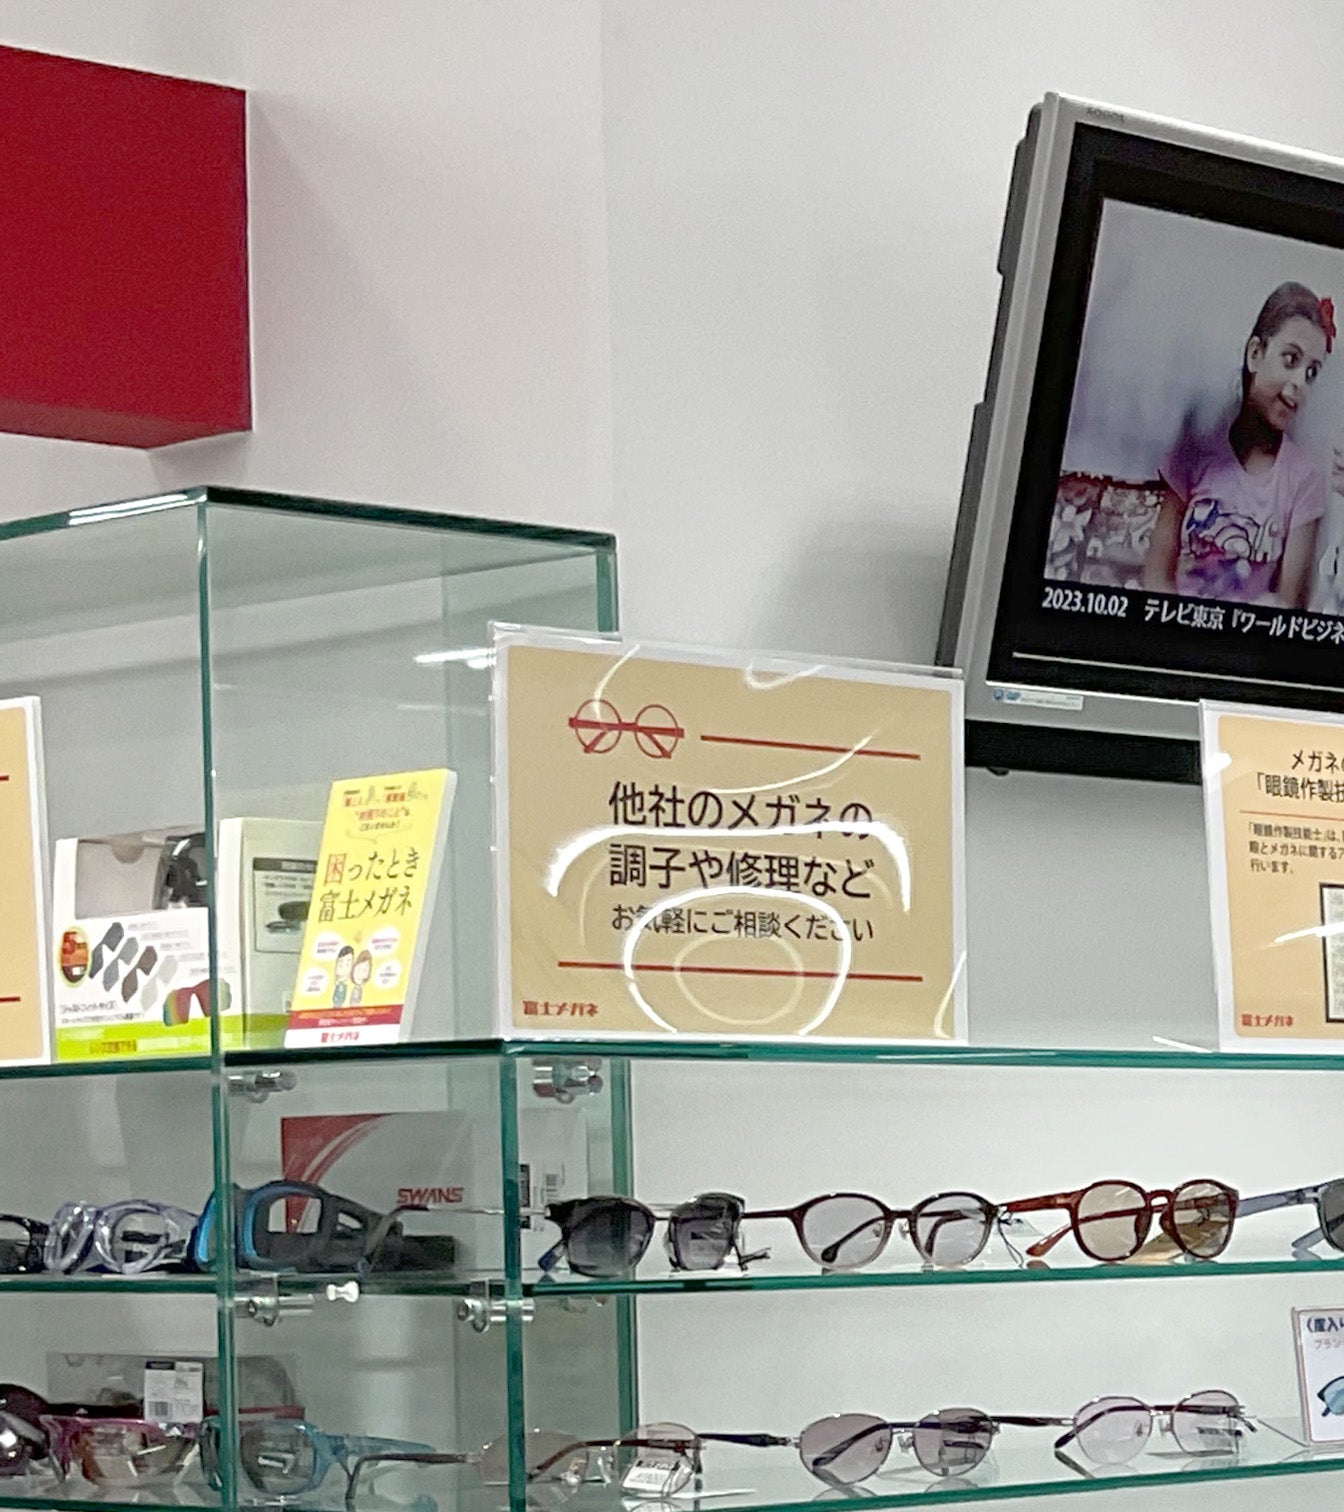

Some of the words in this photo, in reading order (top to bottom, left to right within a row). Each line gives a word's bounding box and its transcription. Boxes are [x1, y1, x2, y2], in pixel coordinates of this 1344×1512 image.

[1042, 586, 1128, 618] 2023.10.02
[609, 781, 873, 840] 他社のメガネの
[324, 847, 420, 886] 困ったとき
[609, 843, 874, 899] 調子や修理など
[319, 886, 413, 923] 富士メガネ
[523, 1001, 598, 1017] 富士メガネ
[1241, 1013, 1294, 1028] 富士メガネ
[397, 1186, 464, 1204] SWANS
